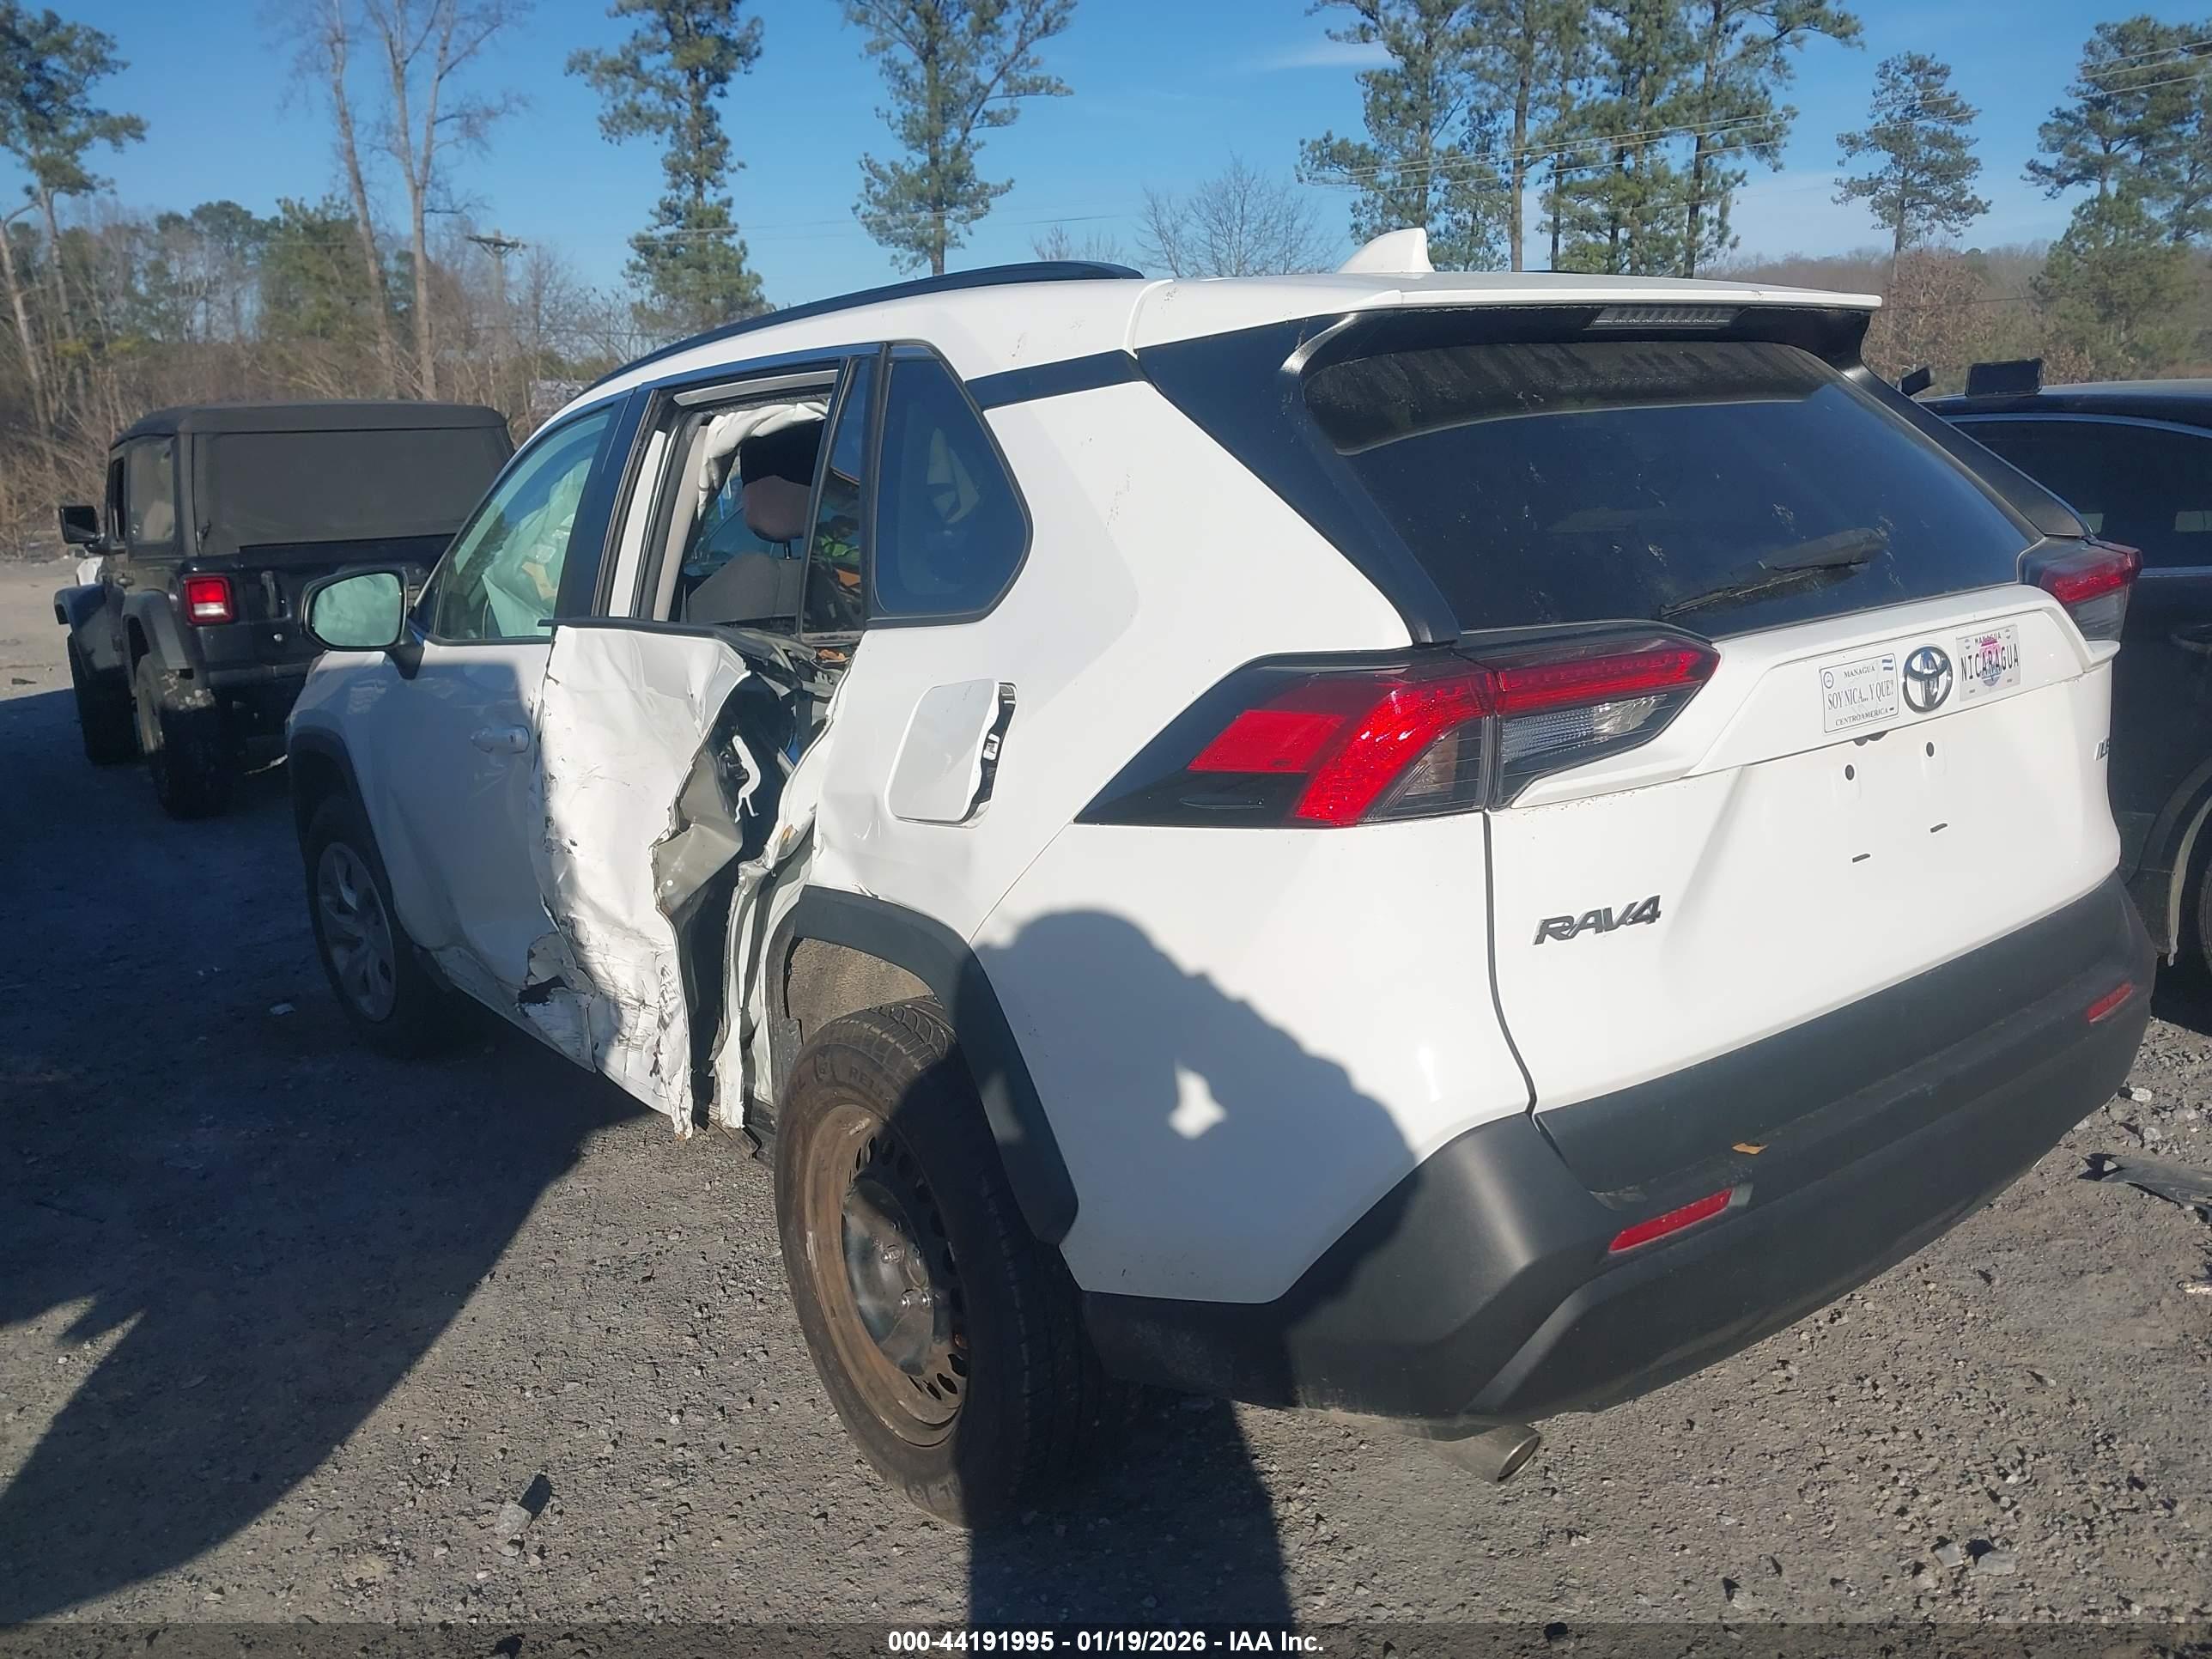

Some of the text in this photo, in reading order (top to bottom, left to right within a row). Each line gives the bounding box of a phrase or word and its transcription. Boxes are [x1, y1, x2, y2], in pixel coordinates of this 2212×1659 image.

[1844, 665, 1875, 679] MANAGUA
[1960, 643, 2019, 682] NICARAGUA
[1827, 679, 1894, 710] SOY NICA... Y QUE?
[1835, 707, 1888, 726] CENTROAMERICA
[1533, 894, 1662, 945] RAV4
